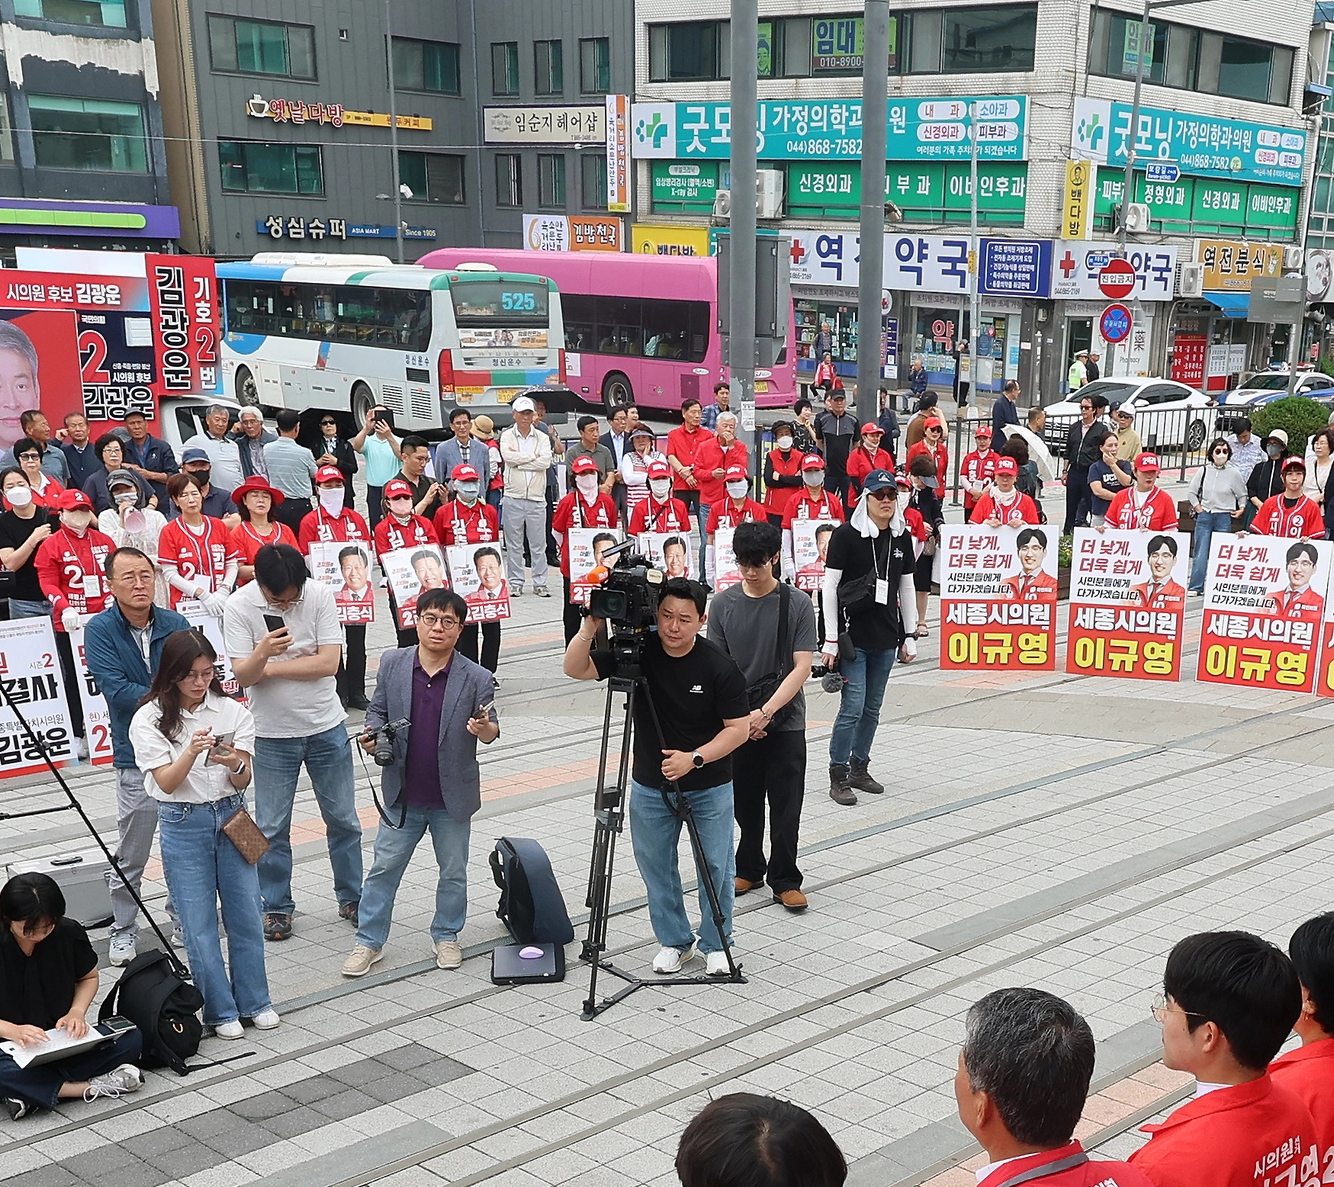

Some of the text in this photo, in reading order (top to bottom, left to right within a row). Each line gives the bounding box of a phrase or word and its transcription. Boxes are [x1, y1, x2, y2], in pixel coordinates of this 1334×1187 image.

[816, 19, 857, 56] 임대
[269, 98, 345, 128] 옛날다방
[979, 102, 1008, 116] 소아과
[515, 111, 598, 134] 임순지 헤어샵
[923, 126, 959, 139] 신경외과
[979, 125, 1007, 139] 피부과
[1114, 111, 1252, 160] 굿모닝 가정의학과의원
[1181, 154, 1229, 169] 044)868-7582
[799, 174, 852, 194] 신경외과
[950, 174, 1025, 197] 이비인후과
[1144, 184, 1185, 206] 정형외과
[1202, 189, 1240, 211] 신경외과
[1252, 194, 1292, 214] 이비인후과
[266, 215, 347, 241] 성심슈퍼
[405, 228, 423, 237] Since
[573, 222, 617, 246] 김밥천국
[1204, 244, 1265, 275] 역전분식
[1101, 274, 1133, 284] 진입금지
[6, 283, 45, 303] 시의원
[48, 286, 72, 303] 후보
[75, 283, 121, 306] 김광운
[501, 292, 535, 310] 525
[155, 265, 191, 391] 김광운
[78, 330, 110, 386] 2
[113, 371, 152, 384] 시의원 후보
[84, 386, 154, 421] 김광운
[74, 492, 84, 501] 2
[949, 536, 1000, 553] 더 낮게,
[1081, 540, 1131, 557] 더 낮게,
[1218, 545, 1269, 563] 더 낮게,
[949, 554, 1012, 569] 더욱 쉽게
[1080, 558, 1143, 575] 더욱 쉽게
[64, 565, 84, 588] 2
[948, 572, 1001, 583] 시민분들에게
[1077, 577, 1130, 589] 시민분들에게
[1216, 563, 1280, 583] 더욱 쉽게
[948, 584, 1012, 596] 다가가겠습니다.
[1077, 588, 1139, 601] 다가가겠습니다.
[1212, 583, 1266, 596] 시민분들에게
[1212, 595, 1276, 609] 다가가겠습니다.
[946, 602, 1050, 627] 세종시의원
[1074, 607, 1176, 636] 세종시의원
[1207, 614, 1312, 646] 세종시의원
[948, 632, 1049, 665] 이규영
[1075, 636, 1173, 675] 이규영
[1206, 645, 1308, 686] 이규영
[1253, 1138, 1293, 1179] 시의원
